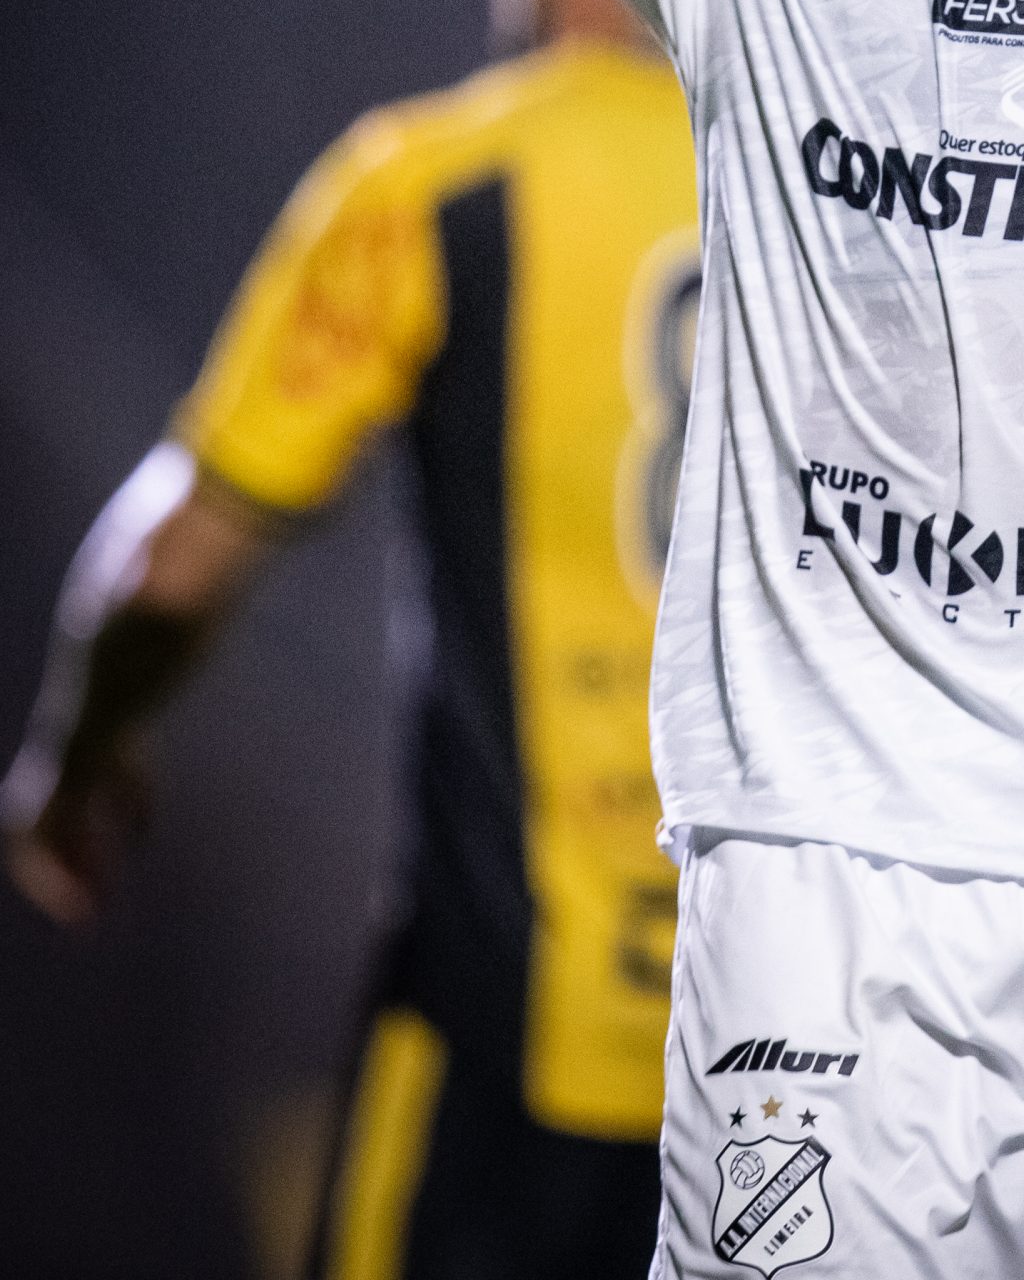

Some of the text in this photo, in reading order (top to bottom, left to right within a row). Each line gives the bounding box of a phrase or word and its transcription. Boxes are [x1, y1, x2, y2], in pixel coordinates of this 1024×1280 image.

[981, 36, 1004, 47] PARA
[938, 129, 976, 153] Quer
[809, 460, 890, 501] RUPO
[704, 1037, 861, 1077] Alluri
[763, 1204, 815, 1256] LIMEIRA
